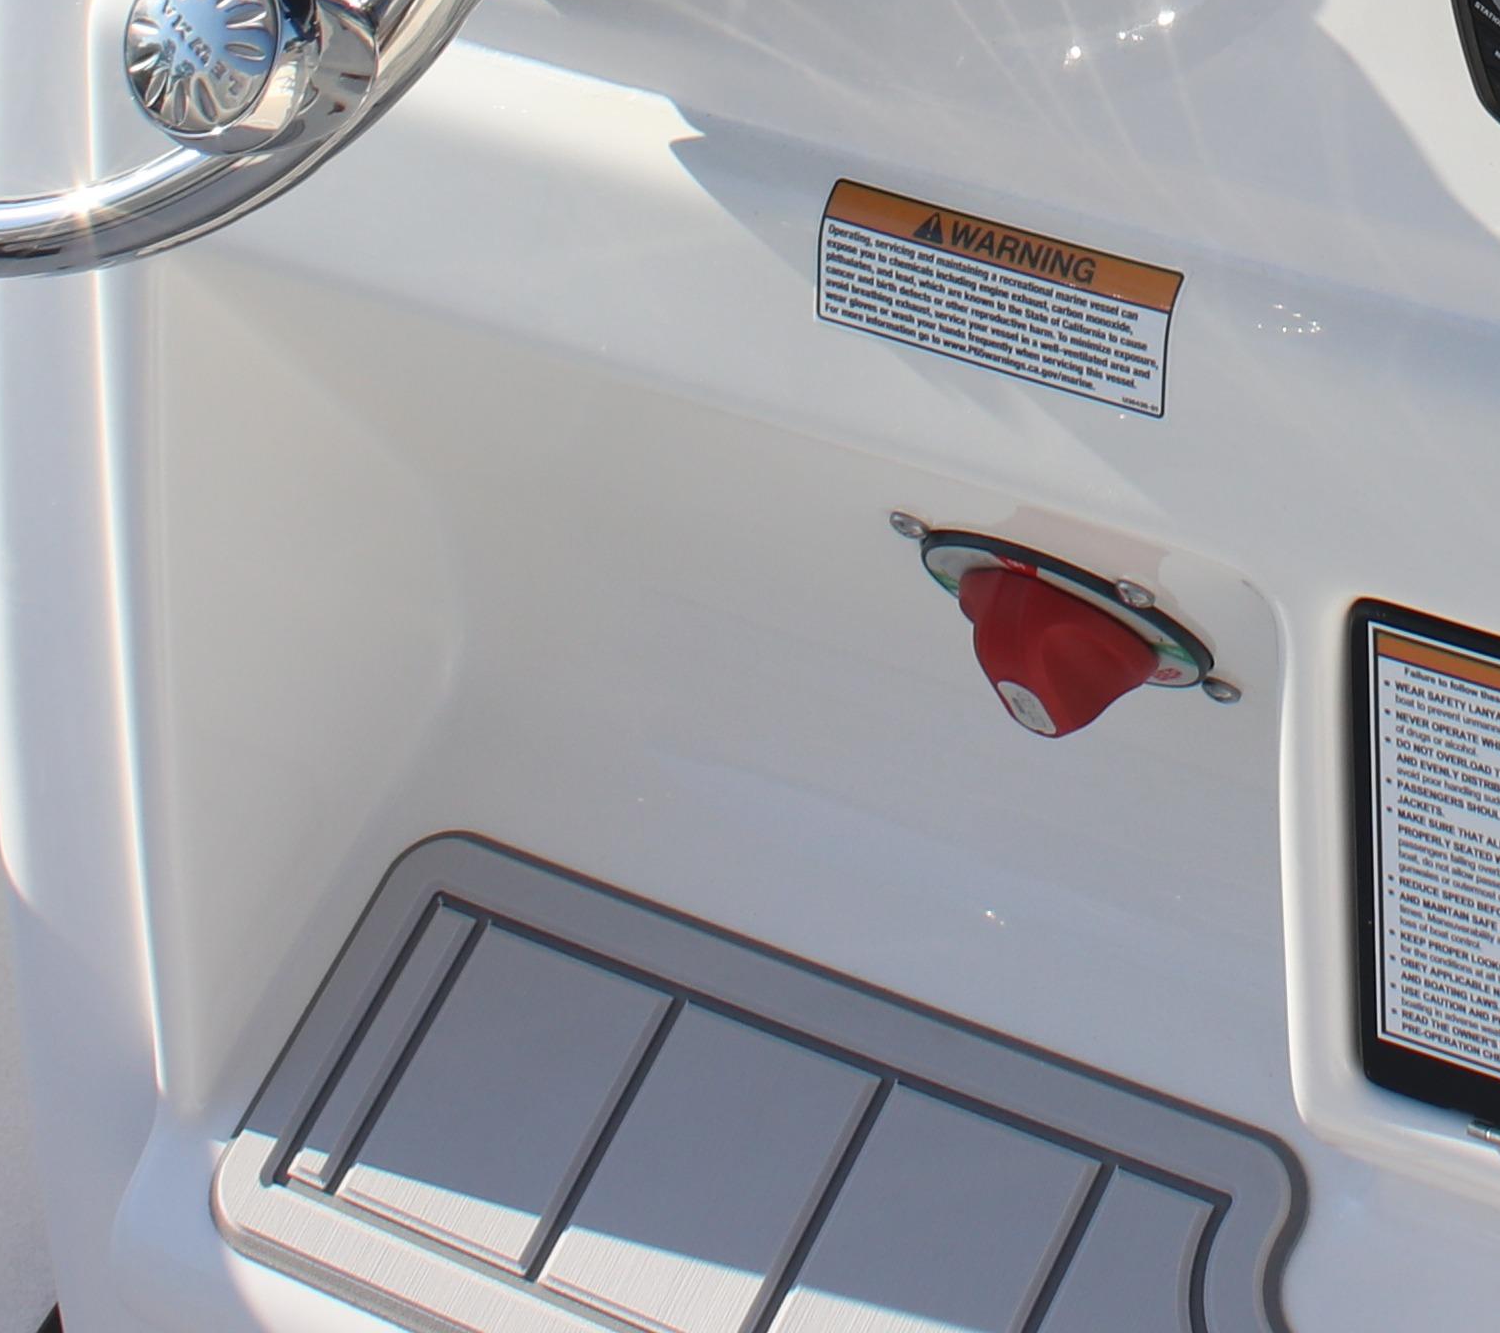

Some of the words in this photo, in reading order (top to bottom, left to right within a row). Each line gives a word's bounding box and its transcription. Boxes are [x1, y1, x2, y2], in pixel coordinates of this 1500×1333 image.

[827, 222, 873, 249] Operating,
[873, 238, 916, 261] servicing
[916, 250, 935, 263] and
[935, 255, 990, 281] maintaining
[989, 271, 998, 281] a
[998, 273, 1055, 297] recreational
[1054, 289, 1088, 307] marine
[1088, 299, 1120, 316] vessel
[1119, 308, 1139, 322] can
[951, 218, 1095, 286] WARNING
[824, 301, 840, 314] For
[840, 308, 862, 321] more
[864, 313, 916, 337] information
[917, 331, 929, 342] go
[931, 332, 941, 344] to
[1394, 680, 1426, 699] WEAR
[1426, 689, 1466, 711] SAFETY
[1394, 737, 1412, 752] DO
[1412, 742, 1435, 759] NOT
[1435, 749, 1492, 777] OVERLOAD
